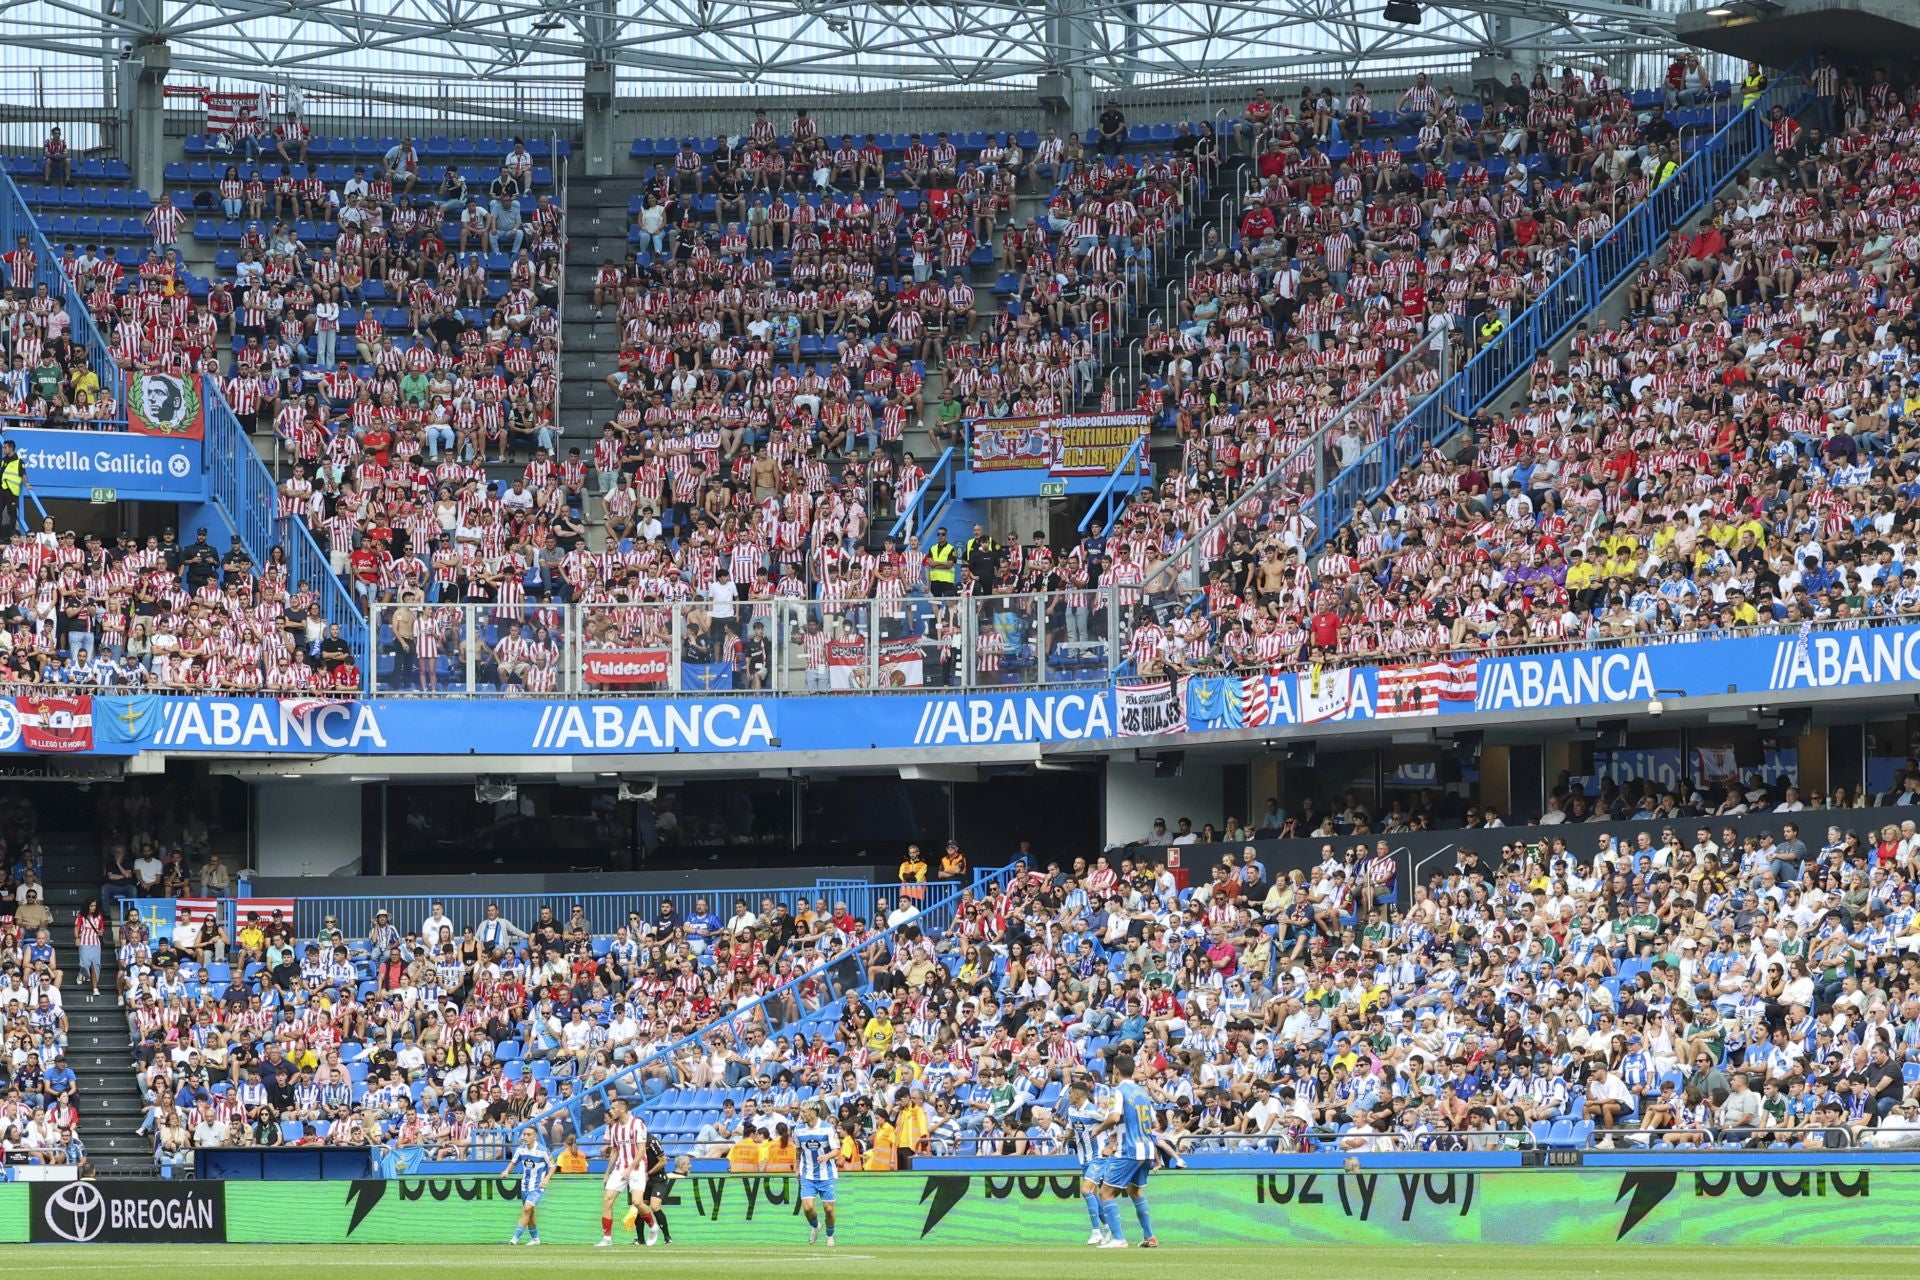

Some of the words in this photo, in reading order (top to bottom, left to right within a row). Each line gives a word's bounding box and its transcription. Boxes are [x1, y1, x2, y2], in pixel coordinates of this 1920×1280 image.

[1056, 415, 1077, 428] PEÑA
[1079, 415, 1148, 427] SPORTINGUISTA
[95, 451, 164, 475] Galicia
[1492, 652, 1655, 710] ABANCA
[175, 702, 387, 748] ABANCA
[555, 704, 774, 749] ABANCA
[934, 694, 1111, 744] ABANCA
[1134, 1104, 1153, 1133] 15
[111, 1191, 213, 1229] BREOGÁN
